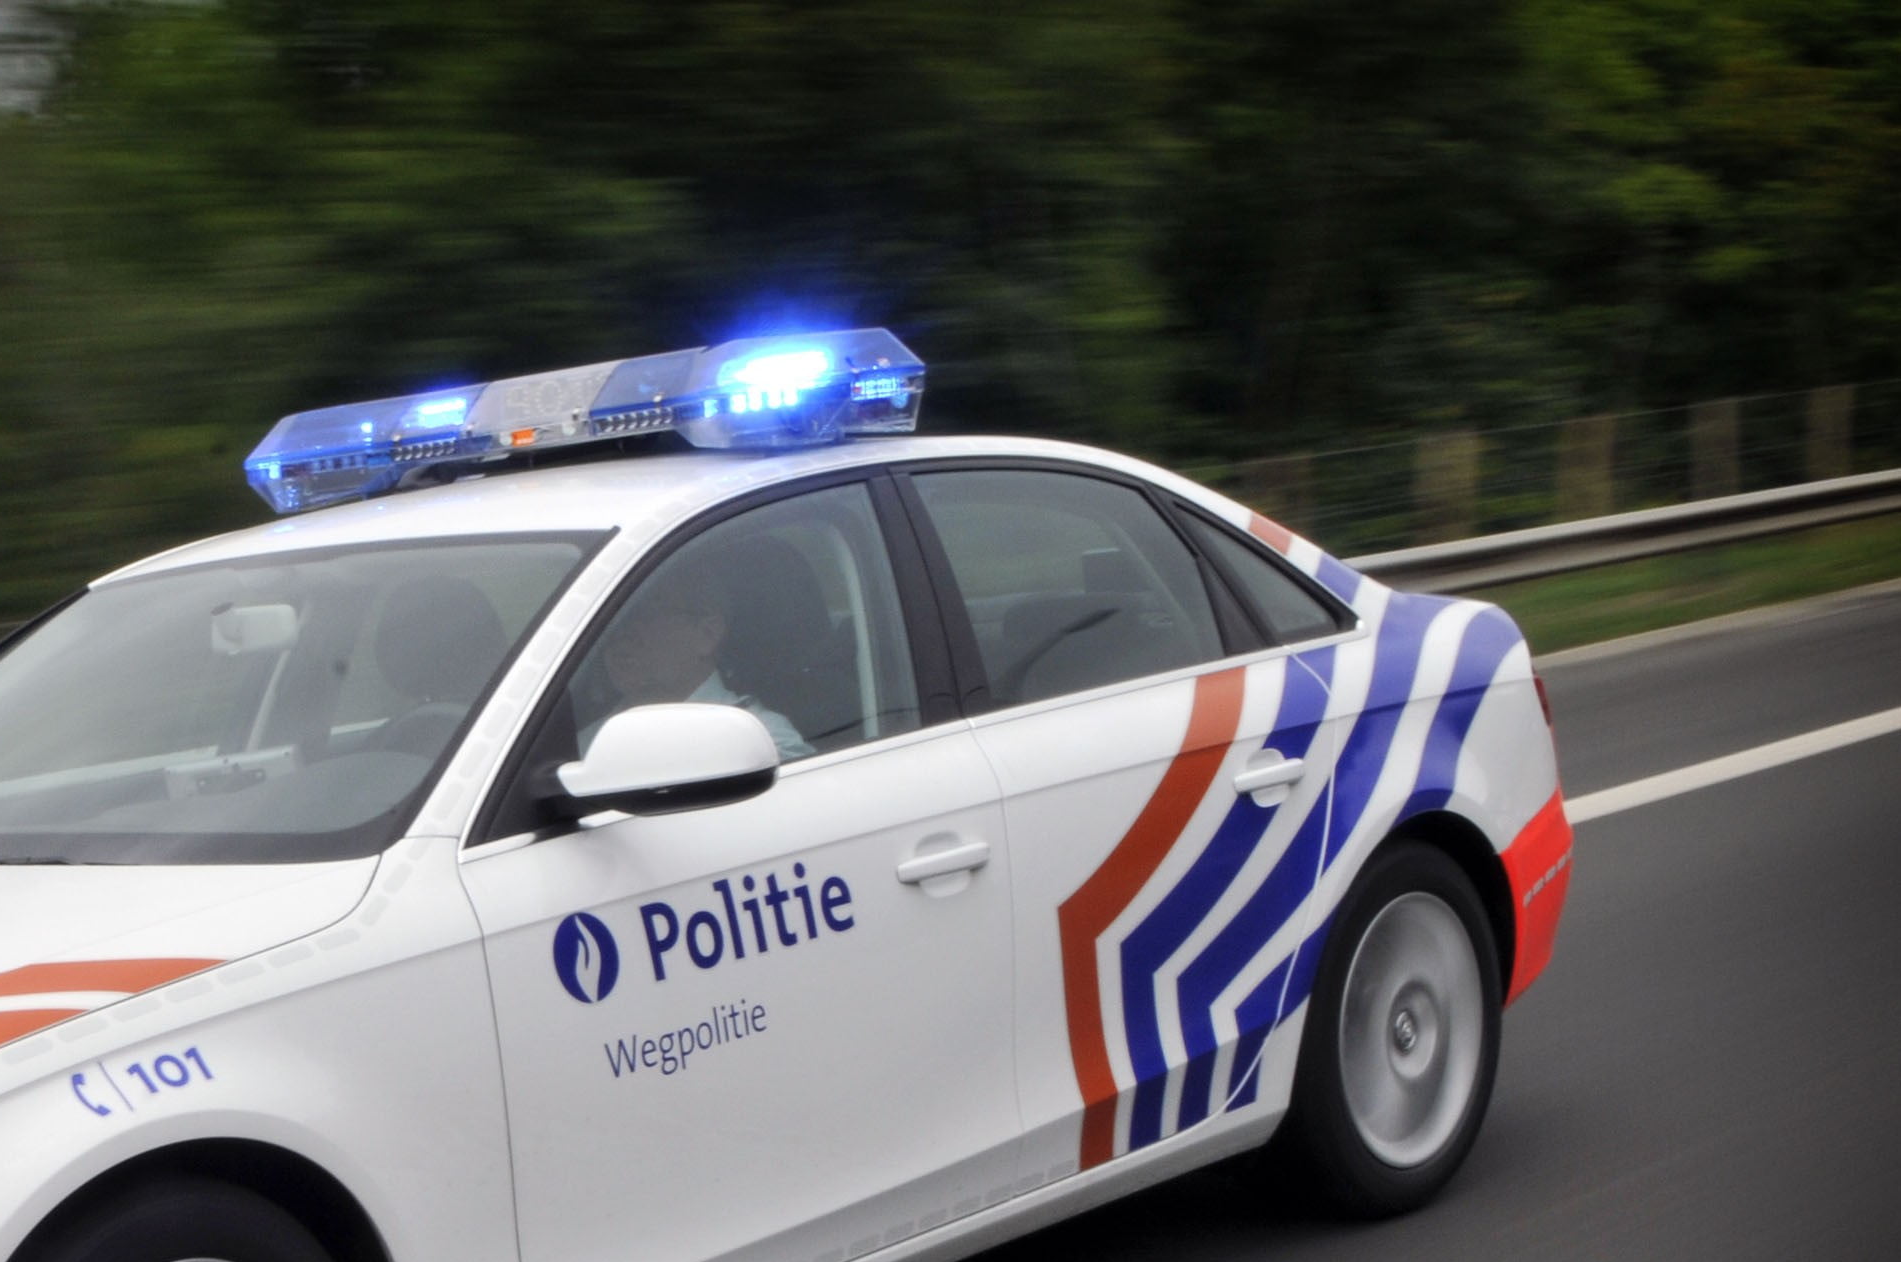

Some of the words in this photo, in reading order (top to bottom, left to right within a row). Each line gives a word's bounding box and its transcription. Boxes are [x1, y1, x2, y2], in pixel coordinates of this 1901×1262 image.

[640, 862, 855, 981] Politie
[127, 1046, 214, 1094] 101
[604, 999, 767, 1078] Wegpolitie
